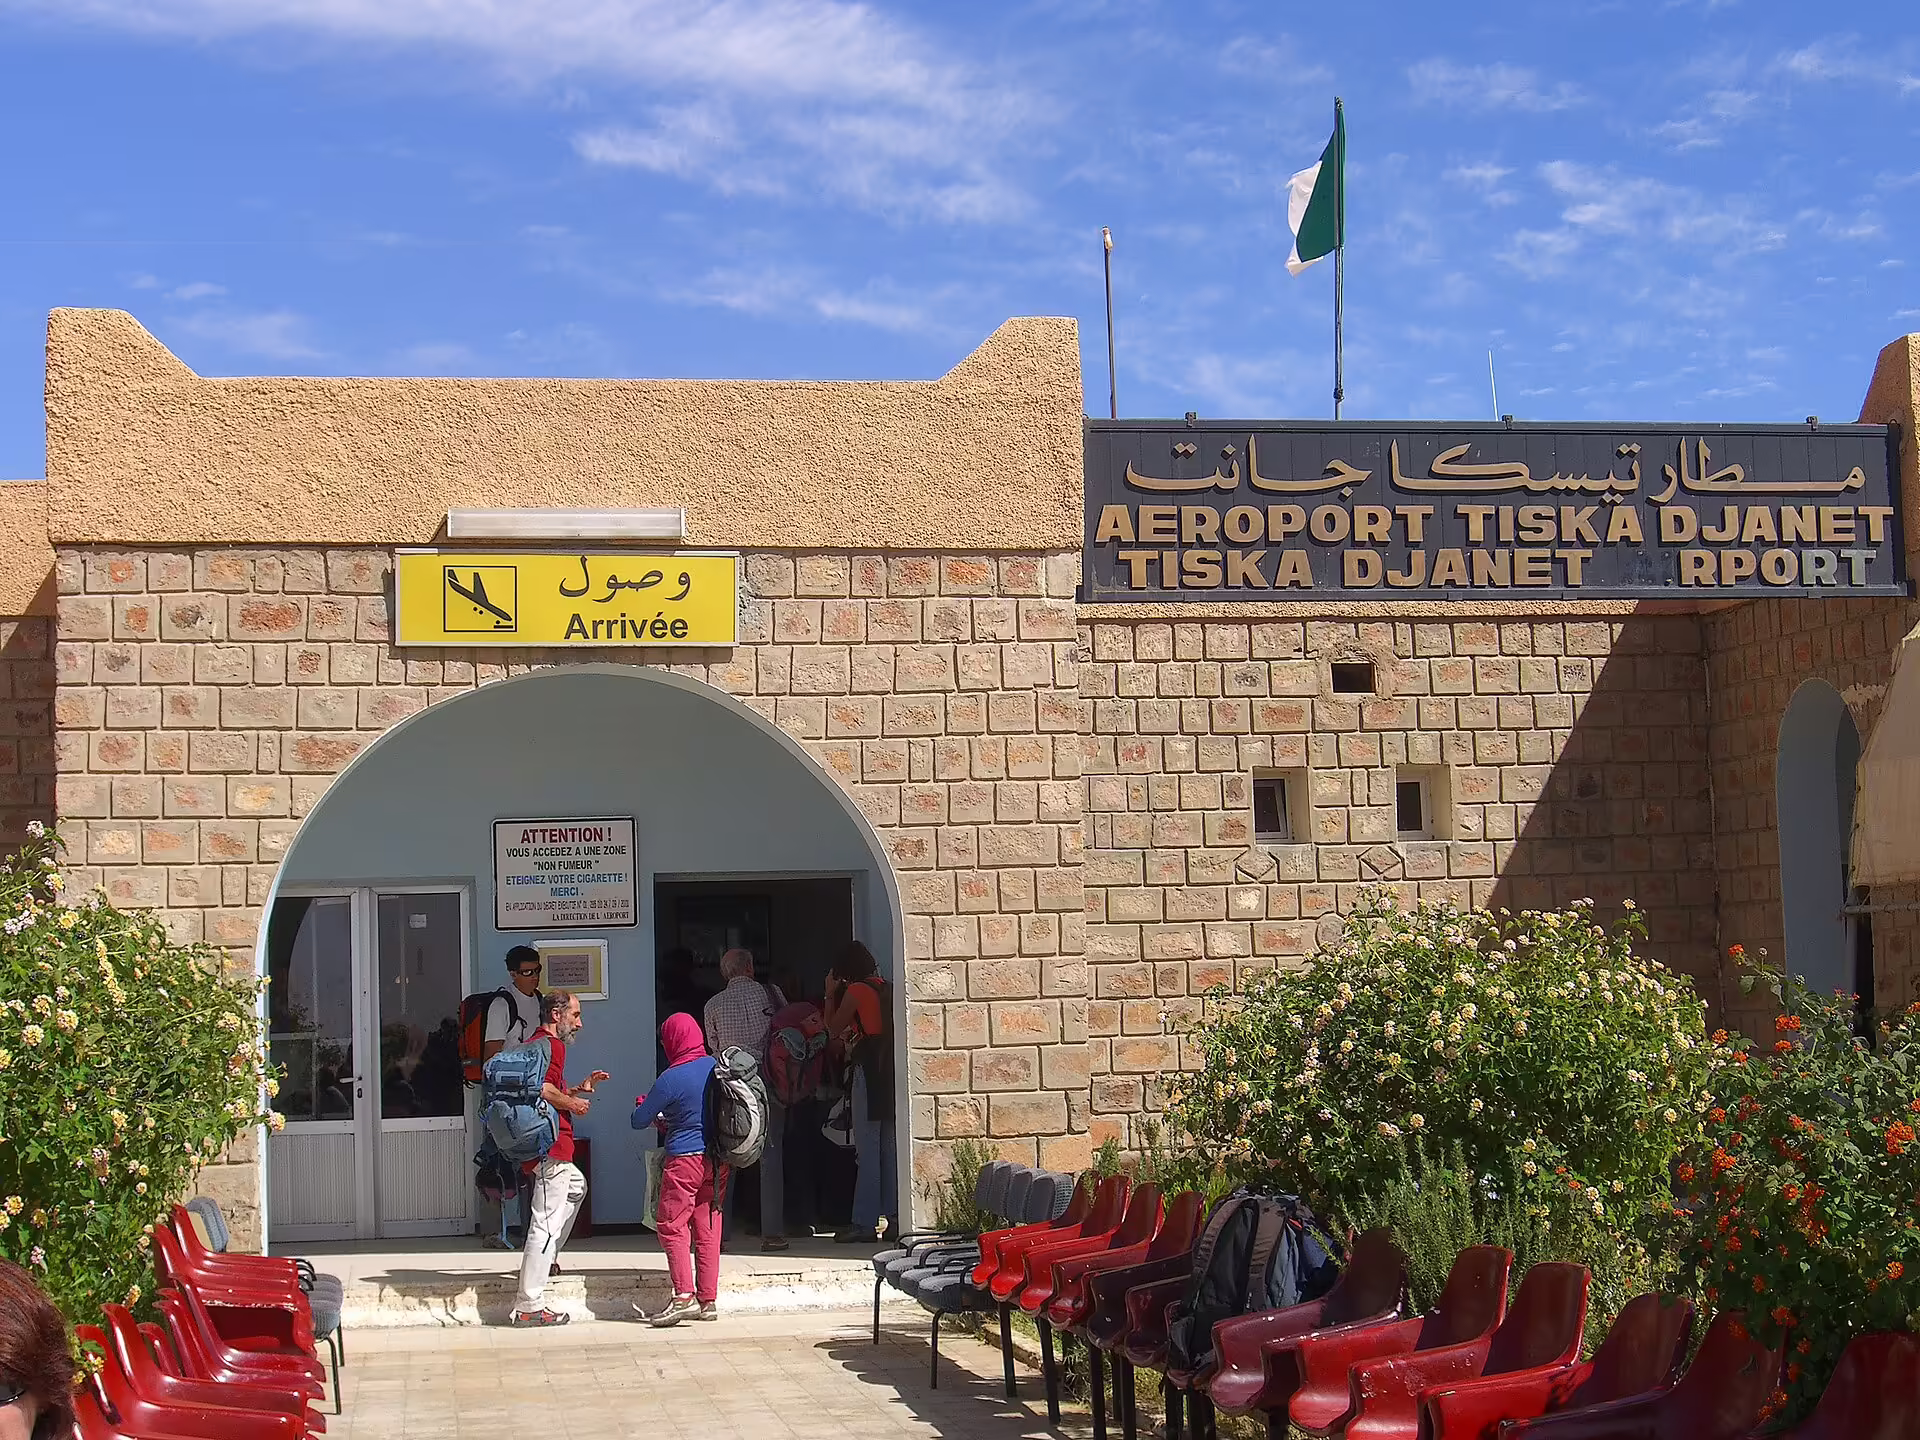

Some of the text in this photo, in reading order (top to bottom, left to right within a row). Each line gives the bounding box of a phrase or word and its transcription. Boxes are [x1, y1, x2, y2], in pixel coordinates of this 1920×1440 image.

[1123, 433, 1865, 505] مطار تيسكا جانت
[1095, 504, 1894, 545] AEROPORT TISKA DJANET
[558, 554, 692, 603] وصول
[1117, 547, 1877, 589] TISKA DJANET RPORT
[563, 612, 690, 640] Arrivée
[520, 827, 603, 844] ATTENTION
[506, 845, 627, 858] VOUS ACCEDEZ A UNE ZONE
[533, 860, 556, 871] "NON
[558, 860, 593, 870] FUMEUR
[505, 874, 546, 886] ETEIGNEZ
[547, 873, 575, 884] VOTRE
[577, 872, 623, 884] CIGARETTE
[550, 887, 579, 897] MERCI
